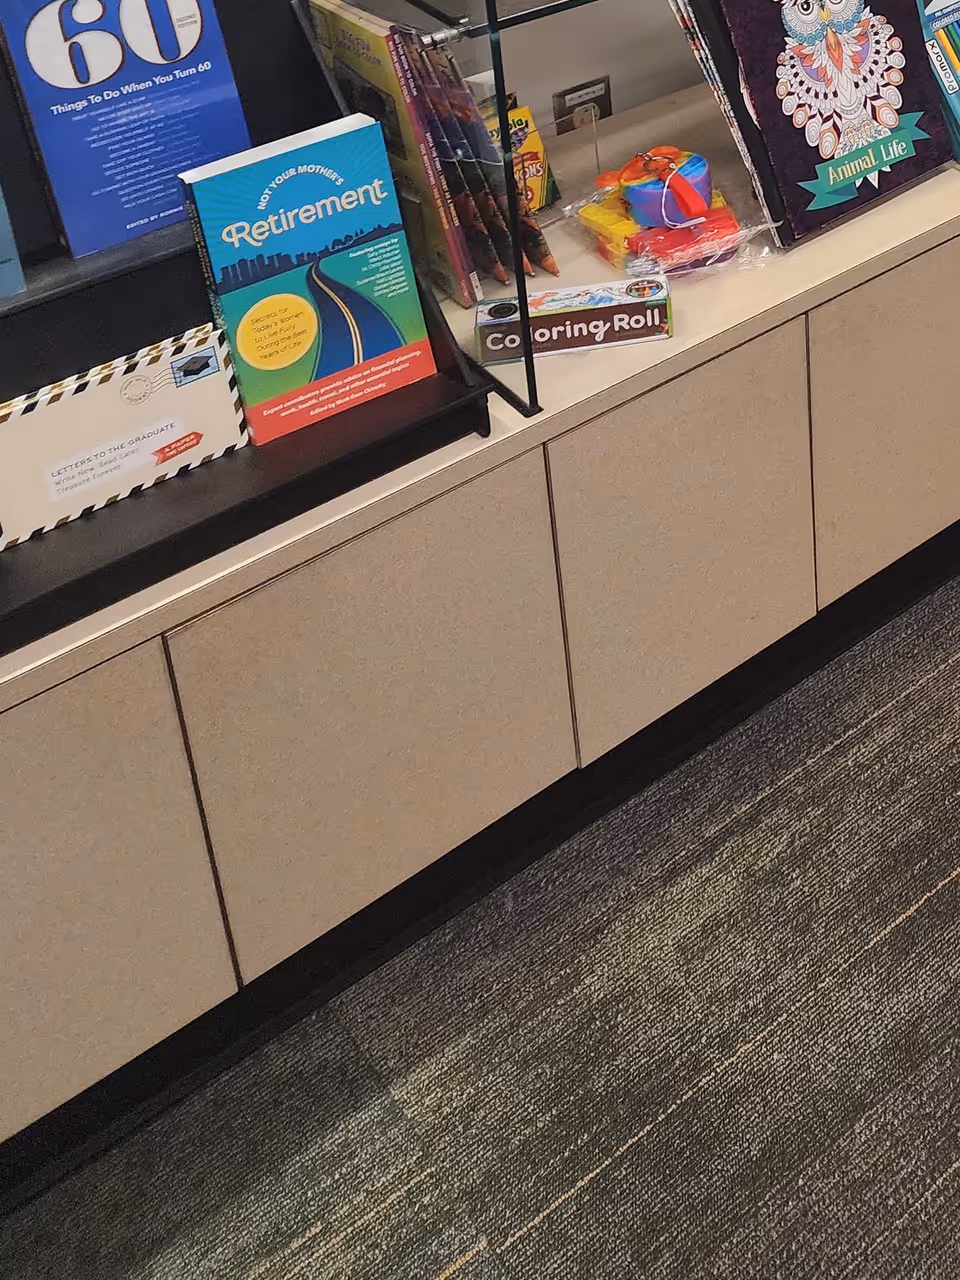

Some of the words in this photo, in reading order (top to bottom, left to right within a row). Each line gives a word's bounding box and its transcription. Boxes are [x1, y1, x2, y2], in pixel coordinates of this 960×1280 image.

[50, 96, 89, 116] Things
[88, 93, 102, 104] To
[103, 90, 120, 101] Do
[120, 79, 153, 95] When
[153, 73, 174, 86] You
[173, 66, 197, 80] Turn
[197, 61, 212, 73] 60
[827, 151, 878, 187] Animal
[881, 138, 908, 161] Life
[256, 187, 273, 210] NOT
[268, 167, 297, 189] YOUR
[297, 164, 345, 186] MOTHER'S
[221, 178, 389, 249] Retirement
[251, 311, 278, 325] Secrets
[278, 306, 288, 318] for
[254, 336, 262, 344] to
[279, 323, 296, 336] Fully
[486, 320, 611, 351] Cooring
[613, 308, 660, 332] Roll
[256, 339, 281, 353] During
[292, 328, 308, 339] Best
[51, 455, 93, 478] LETTERS
[93, 451, 106, 460] TO
[107, 443, 127, 454] THE
[127, 421, 176, 446] GRADUATE
